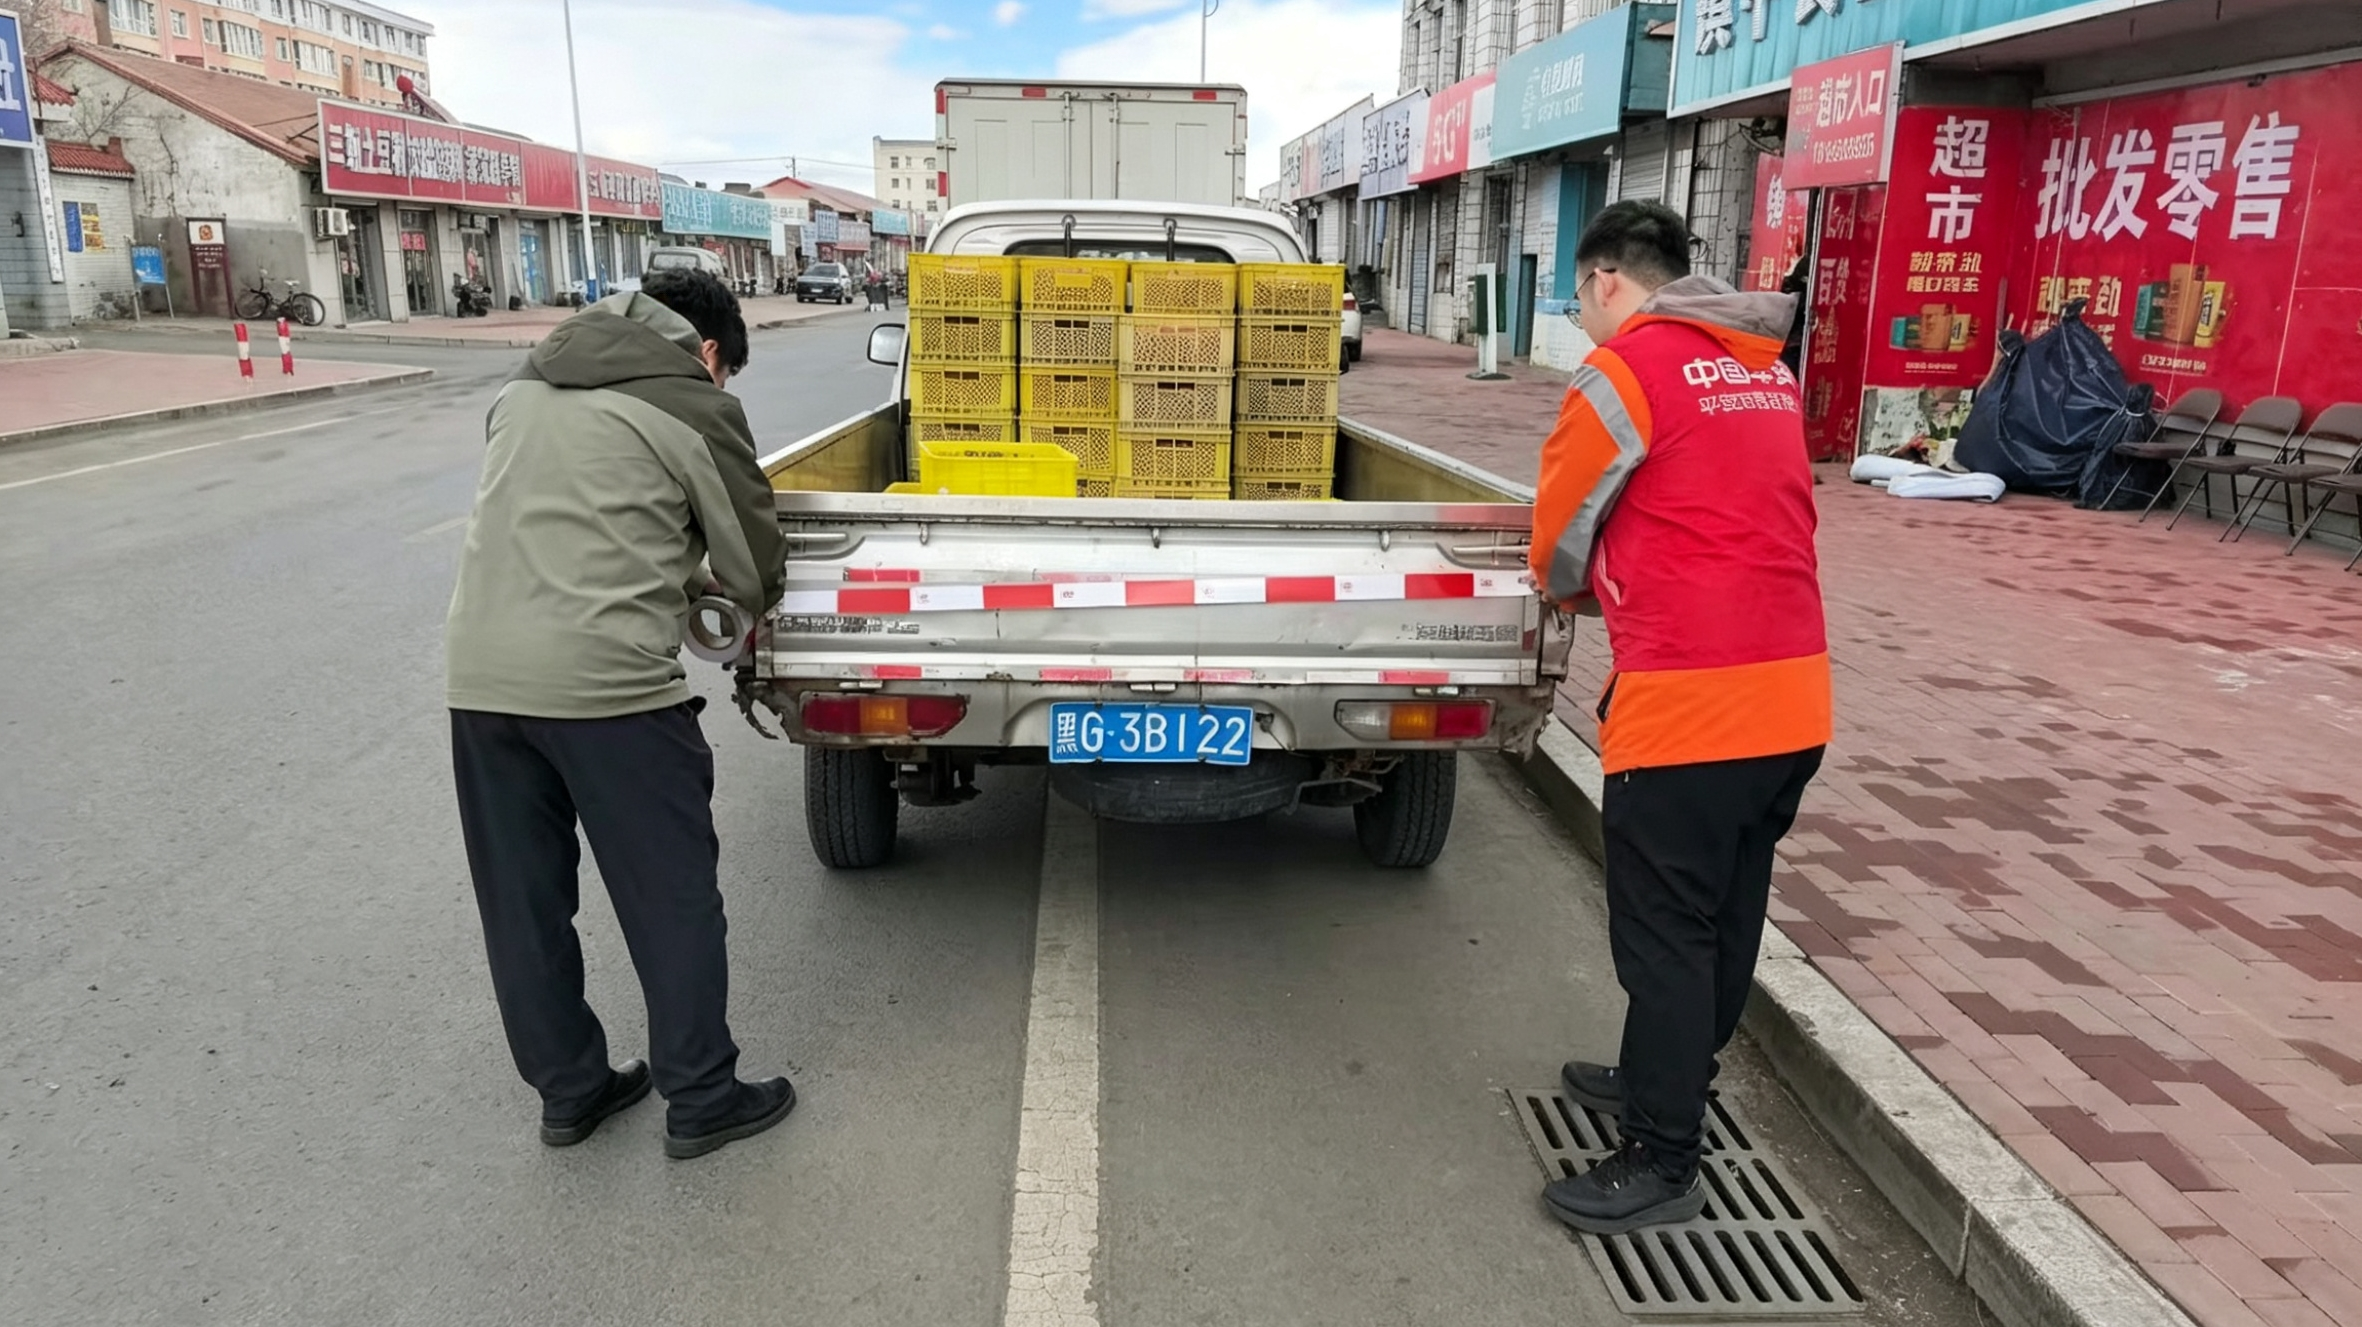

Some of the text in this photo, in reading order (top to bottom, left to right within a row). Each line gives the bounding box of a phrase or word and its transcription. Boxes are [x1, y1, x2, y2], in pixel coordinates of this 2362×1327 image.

[1926, 115, 1990, 243] 超市
[2034, 111, 2300, 243] 批发零售
